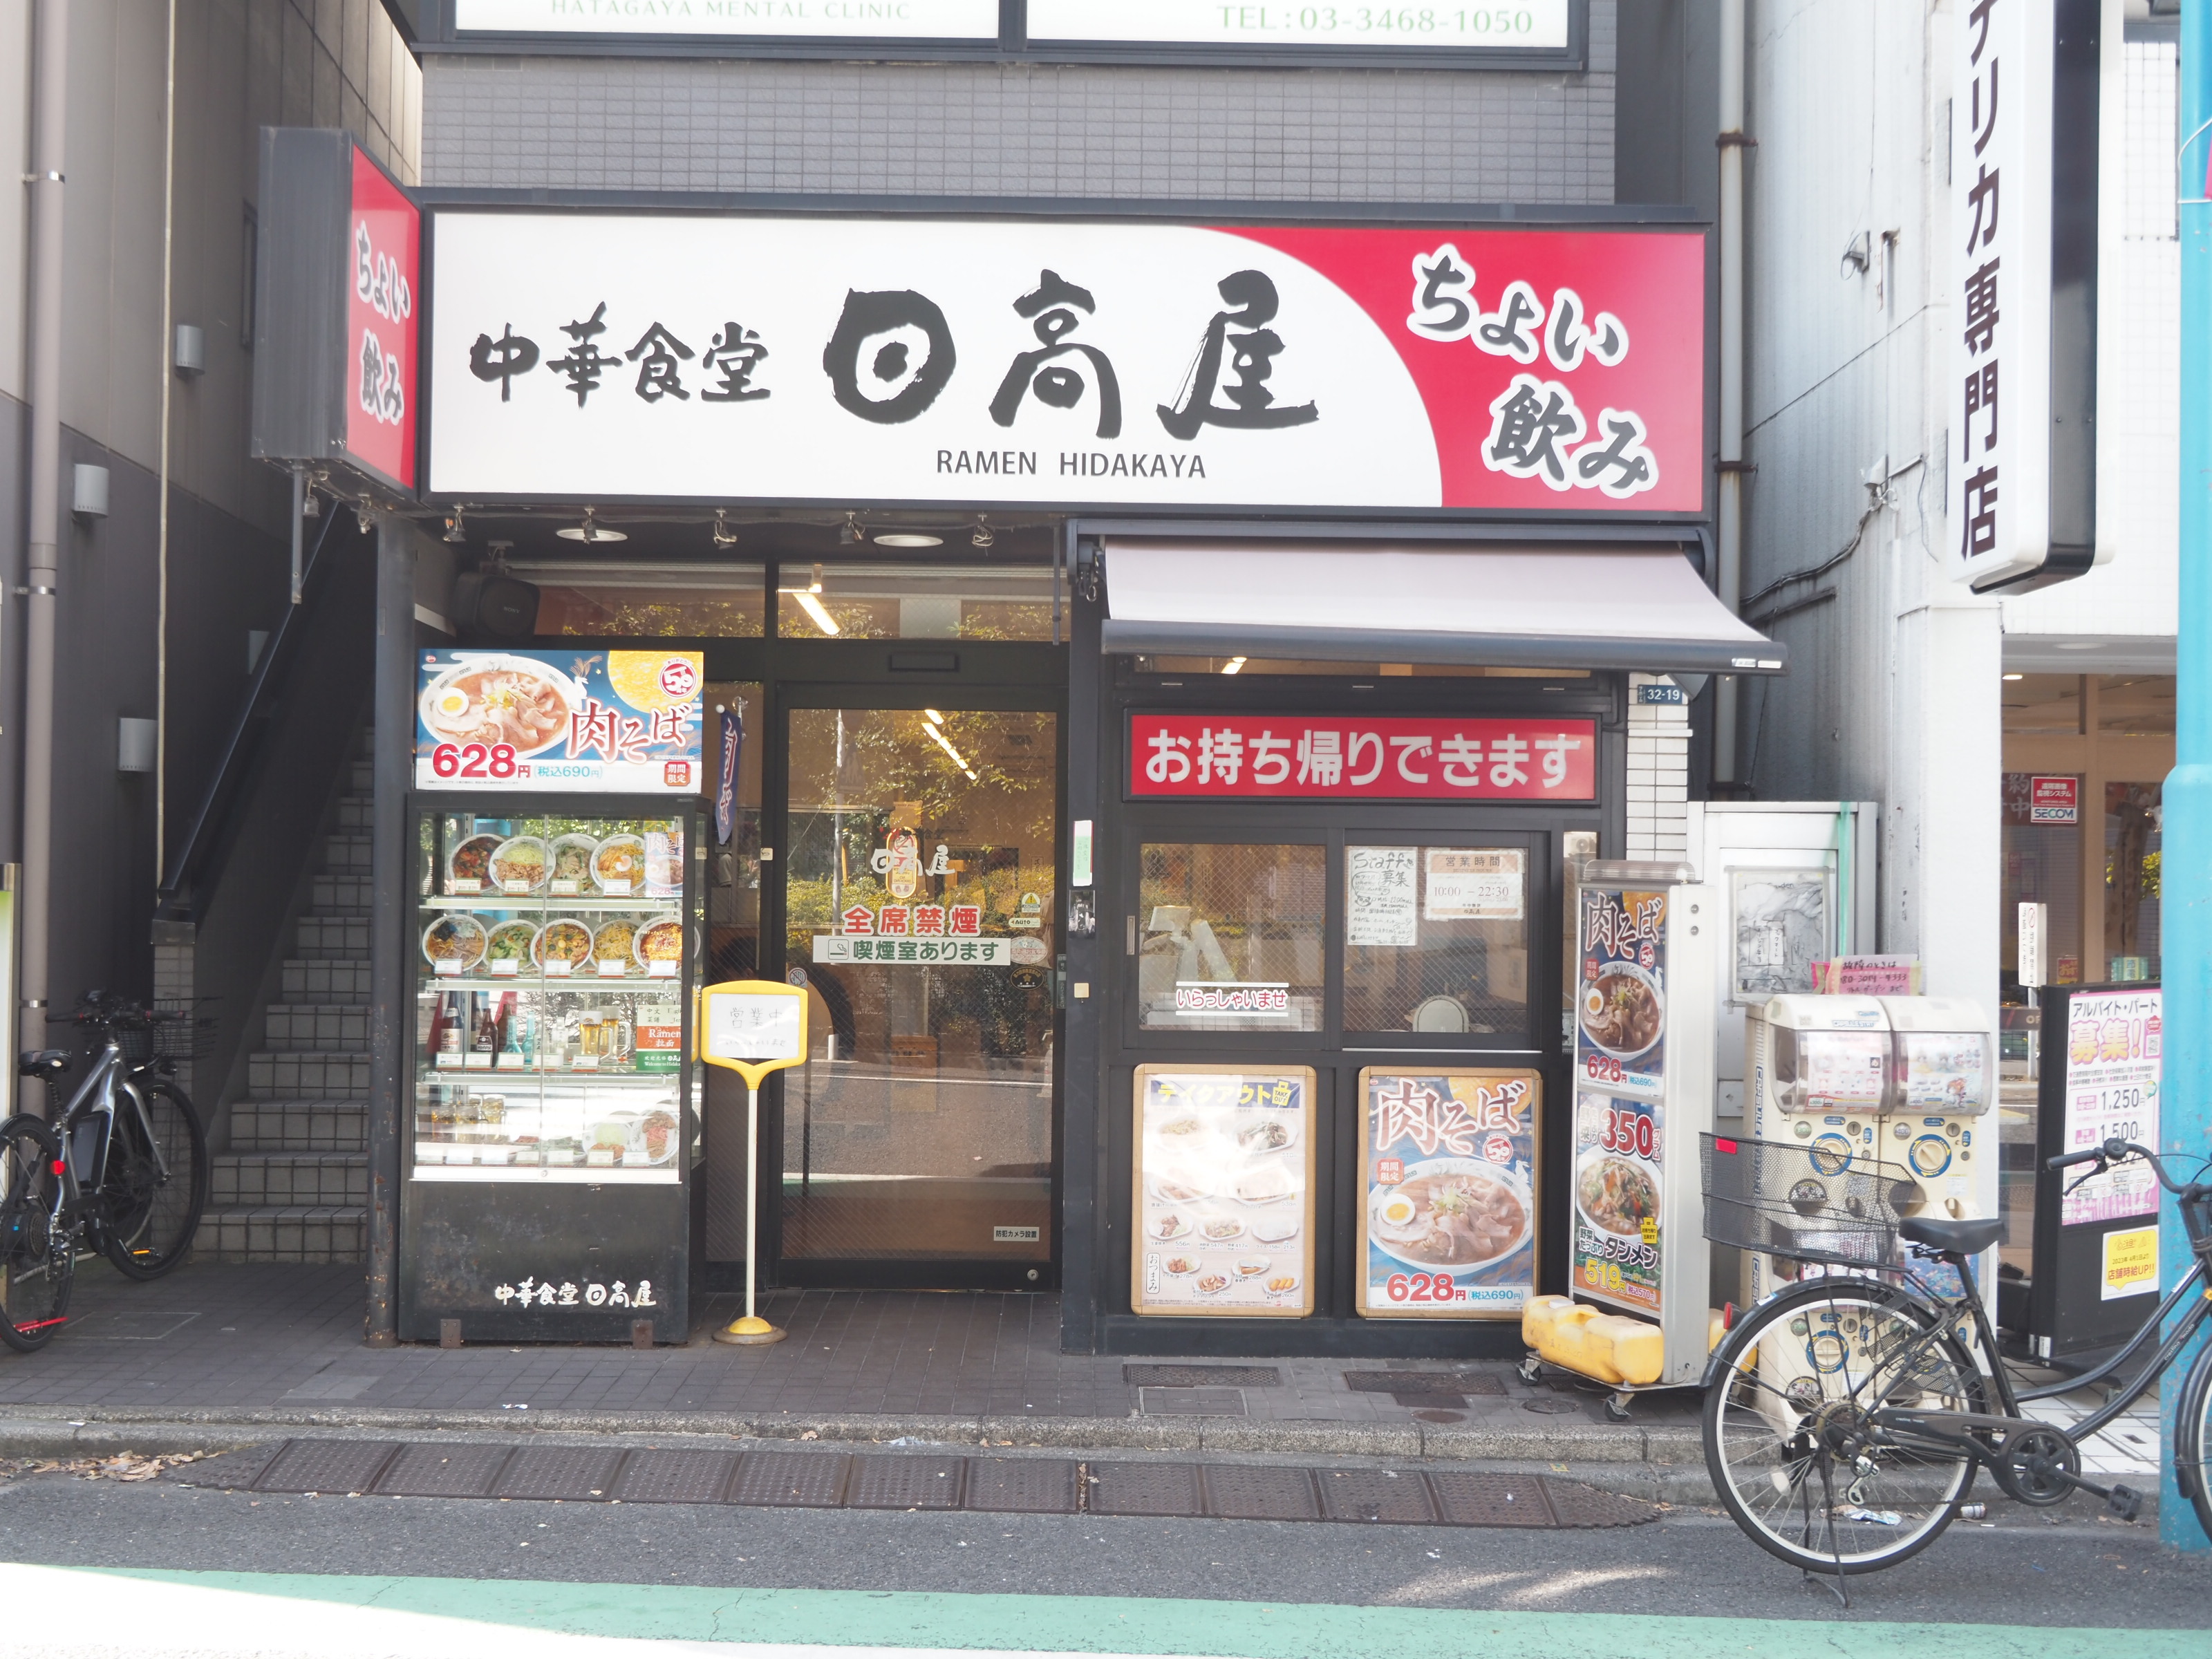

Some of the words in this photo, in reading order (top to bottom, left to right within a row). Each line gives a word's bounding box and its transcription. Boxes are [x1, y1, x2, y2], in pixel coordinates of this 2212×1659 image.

[552, 0, 693, 15] HATAGAYA
[706, 1, 810, 17] MENTAL
[825, 3, 910, 20] CLINIC
[358, 223, 410, 322] ちょい
[1412, 249, 1623, 366] ちょい
[469, 300, 771, 408] 中華食堂
[822, 268, 1321, 441] 日高屋
[362, 330, 404, 424] 飲み
[1486, 379, 1653, 493] 飲み
[937, 449, 1038, 476] RAMEN
[1060, 451, 1207, 480] HIDAKAYA
[1647, 688, 1680, 700] 32-19
[565, 699, 692, 765] 肉そば
[432, 743, 531, 780] 628円
[667, 764, 687, 774] 期間
[1145, 728, 1582, 788] お持ち帰りできます
[667, 774, 687, 784] 限定
[2034, 809, 2074, 819] SECOM
[870, 845, 956, 877] 日高屋
[1445, 856, 1500, 867] 営業時間
[1434, 886, 1461, 897] 10:00
[1478, 886, 1509, 897] 22:30
[843, 906, 980, 935] 全席禁煙
[1586, 892, 1662, 959] 肉そば
[853, 941, 999, 962] 喫煙室あります
[1842, 959, 1897, 971] 故障のときは
[1177, 989, 1287, 1009] いらっしゃいませ
[2073, 997, 2158, 1018] アルバイト・パート
[730, 1007, 782, 1029] 営業中
[2069, 1018, 2141, 1065] 募集!
[1587, 1054, 1627, 1085] 628円
[1376, 1078, 1527, 1156] 肉そば
[1600, 1108, 1654, 1159] 350
[1652, 1129, 1661, 1161] グラム
[1380, 1161, 1400, 1172] 期間
[1380, 1172, 1400, 1182] 限定
[995, 1230, 1038, 1238] 防犯カメラ設置
[1580, 1227, 1594, 1241] 野菜
[1580, 1239, 1604, 1257] たっぷり
[1604, 1235, 1658, 1269] タンメン
[1148, 1255, 1159, 1291] おつまみ
[2107, 1263, 2155, 1280] 店舗時給UP!!
[495, 1275, 579, 1309] 中華食堂
[585, 1280, 657, 1308] 日高屋
[1387, 1273, 1466, 1302] 628円
